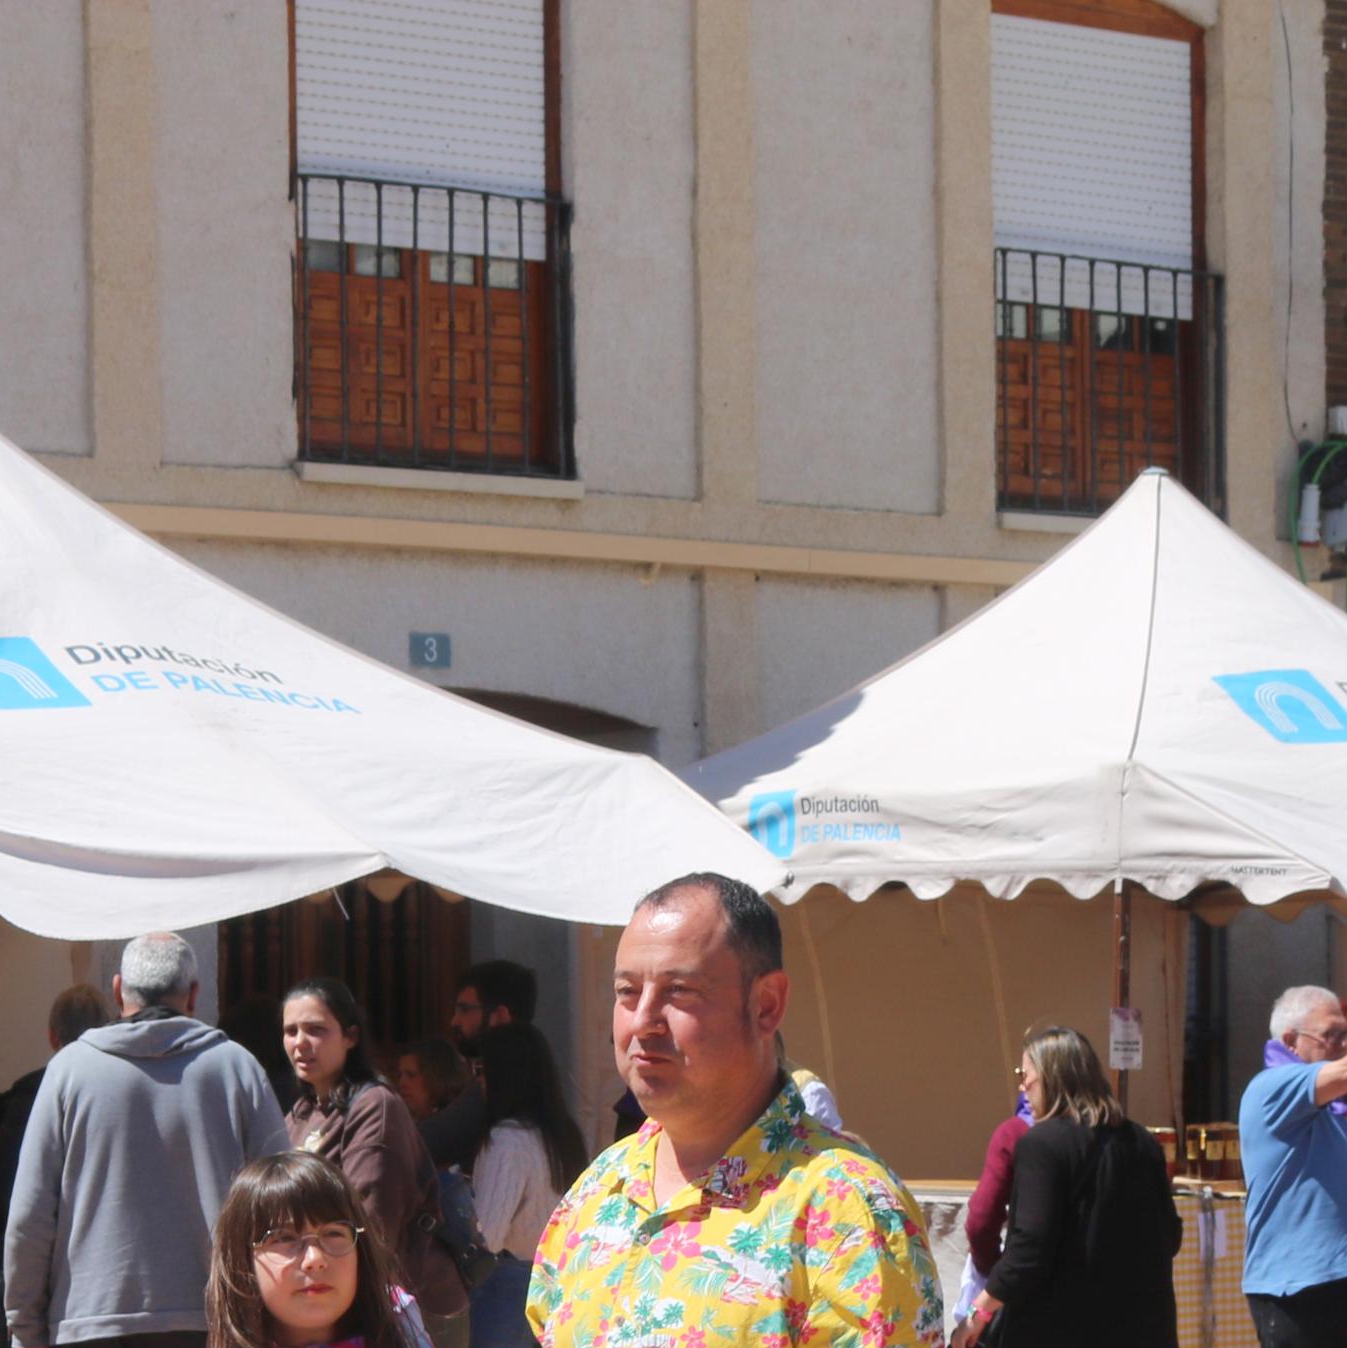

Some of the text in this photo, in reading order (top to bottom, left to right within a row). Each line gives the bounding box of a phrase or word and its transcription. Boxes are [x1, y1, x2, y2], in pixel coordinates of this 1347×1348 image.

[424, 637, 437, 662] 3
[64, 642, 284, 684] Diputación
[91, 670, 363, 714] DE PALENCIA
[800, 794, 880, 818] Diputación
[800, 821, 901, 844] DE PALENCIA
